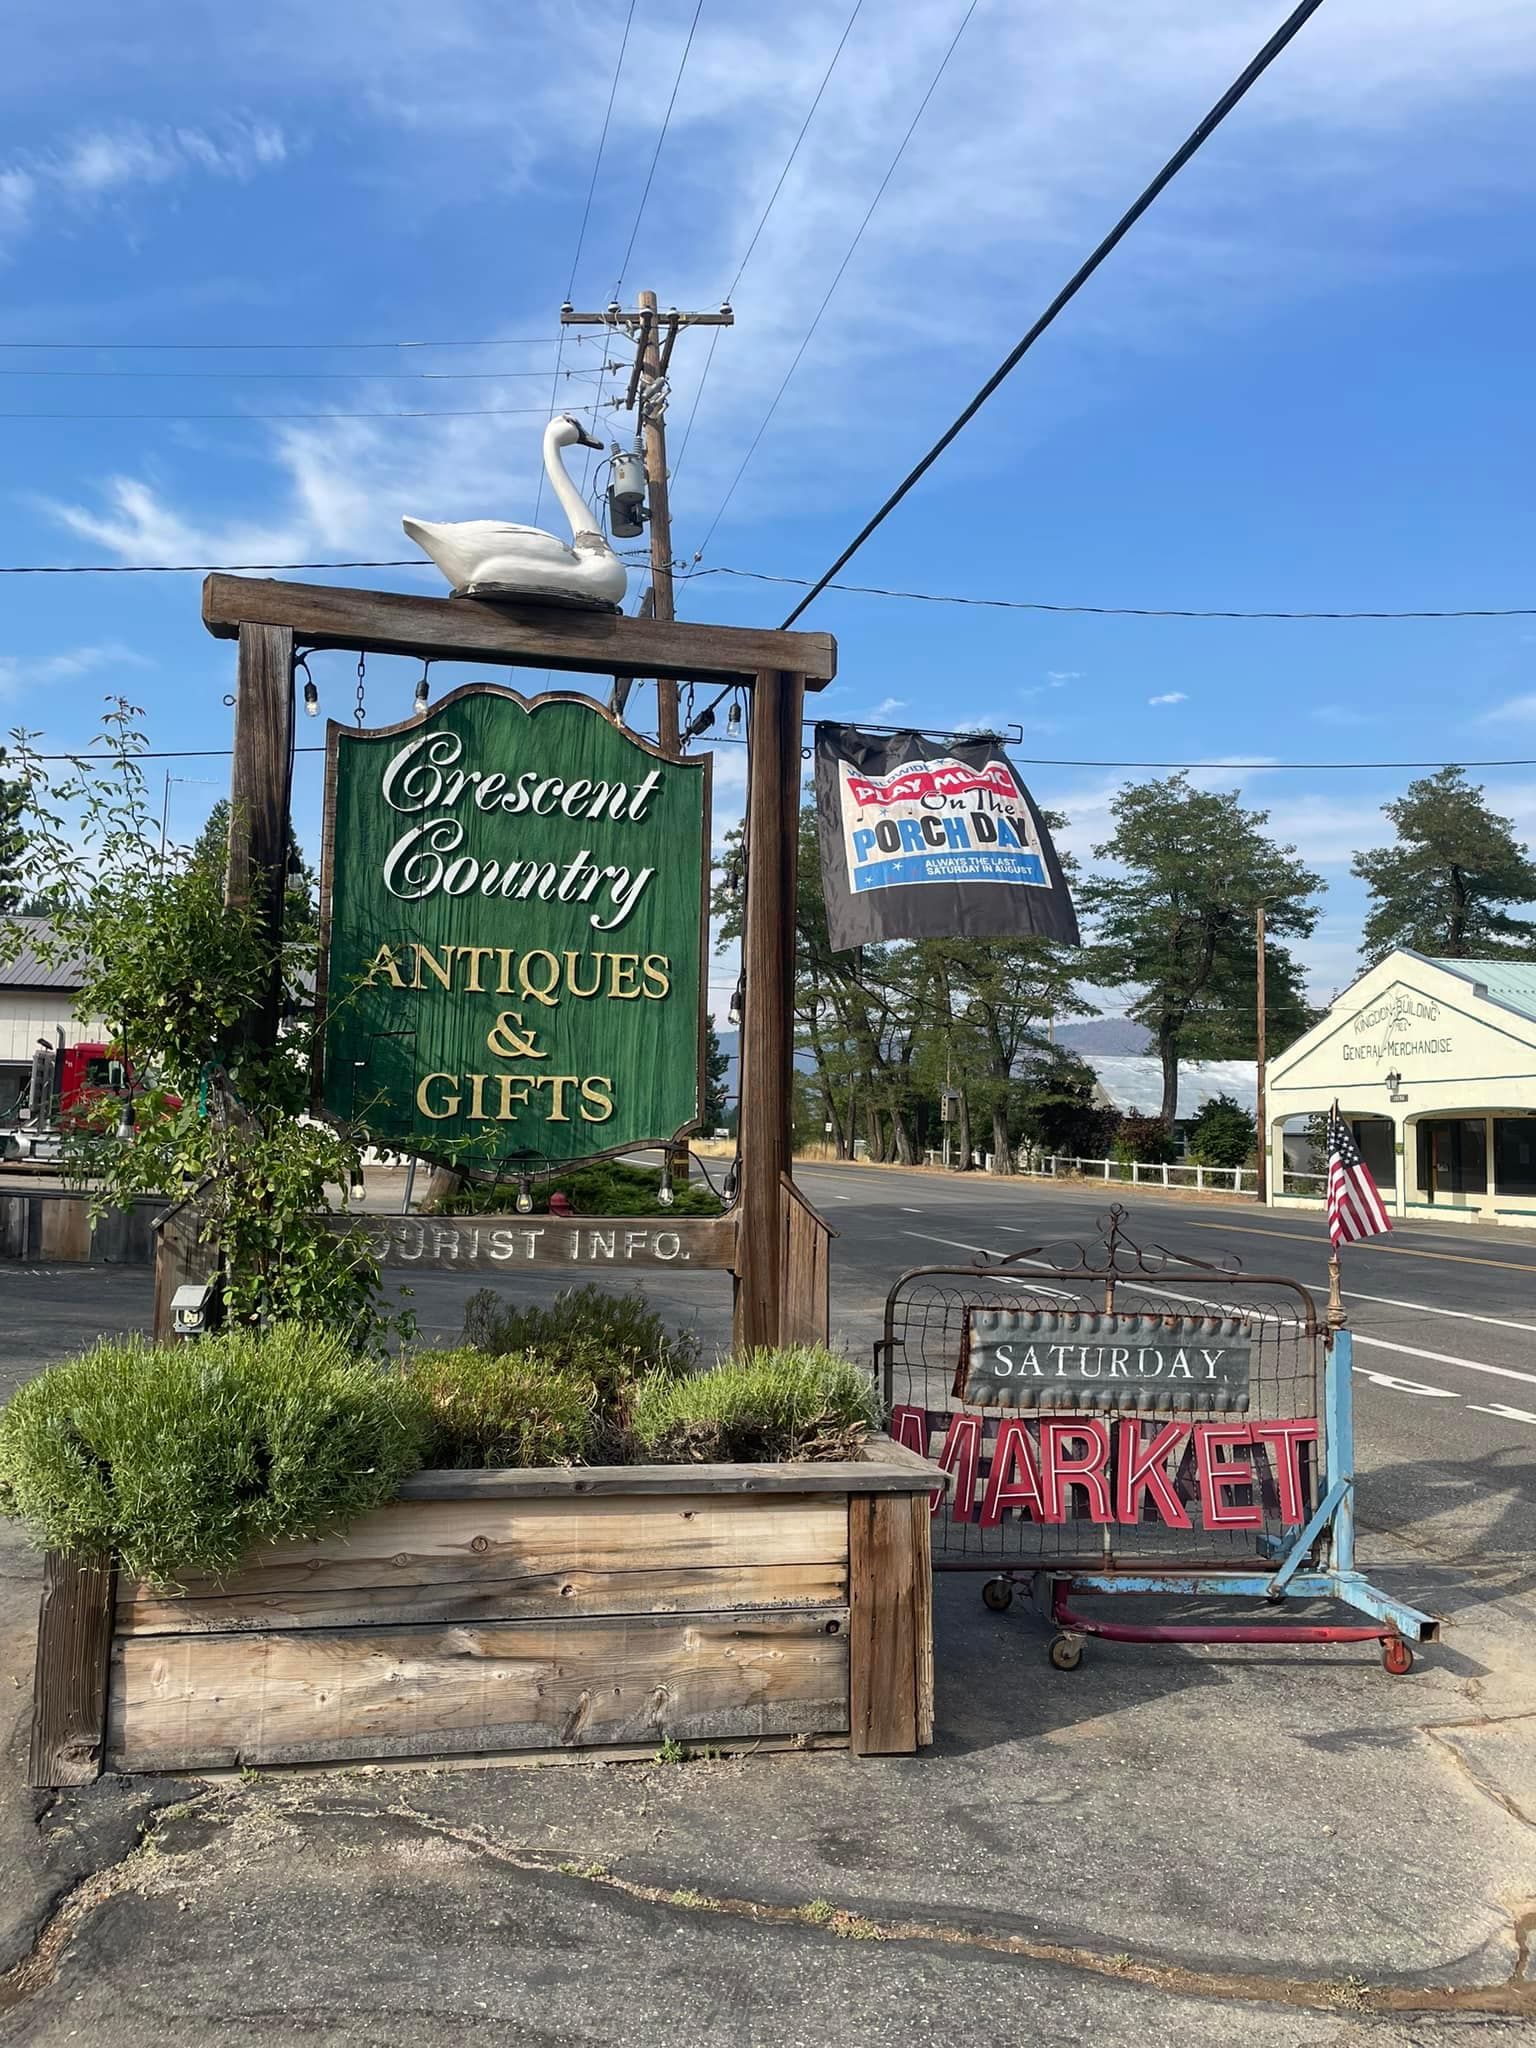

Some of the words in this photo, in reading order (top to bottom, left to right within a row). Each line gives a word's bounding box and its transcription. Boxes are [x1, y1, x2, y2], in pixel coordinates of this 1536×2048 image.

[382, 731, 662, 822] Crescent
[855, 778, 922, 801] PLAY
[920, 791, 966, 811] On
[964, 787, 1015, 815] The
[853, 815, 971, 863] PORCH
[971, 812, 1029, 848] DAY
[383, 818, 655, 930] Country
[925, 857, 967, 868] ALWAYS
[968, 857, 990, 867] THE
[990, 858, 1017, 867] LAST
[927, 866, 982, 876] SATURDAY
[994, 866, 1033, 875] AUGUST
[366, 943, 671, 1006] ANTIQUES
[486, 1011, 548, 1058] &
[1342, 1044, 1384, 1061] GENERAL
[1387, 1037, 1453, 1057] MERCHANDISE
[416, 1073, 614, 1122] GIFTS
[569, 1229, 691, 1260] INFO.
[993, 1344, 1226, 1380] SATURDAY
[892, 1404, 1318, 1529] MARKET
